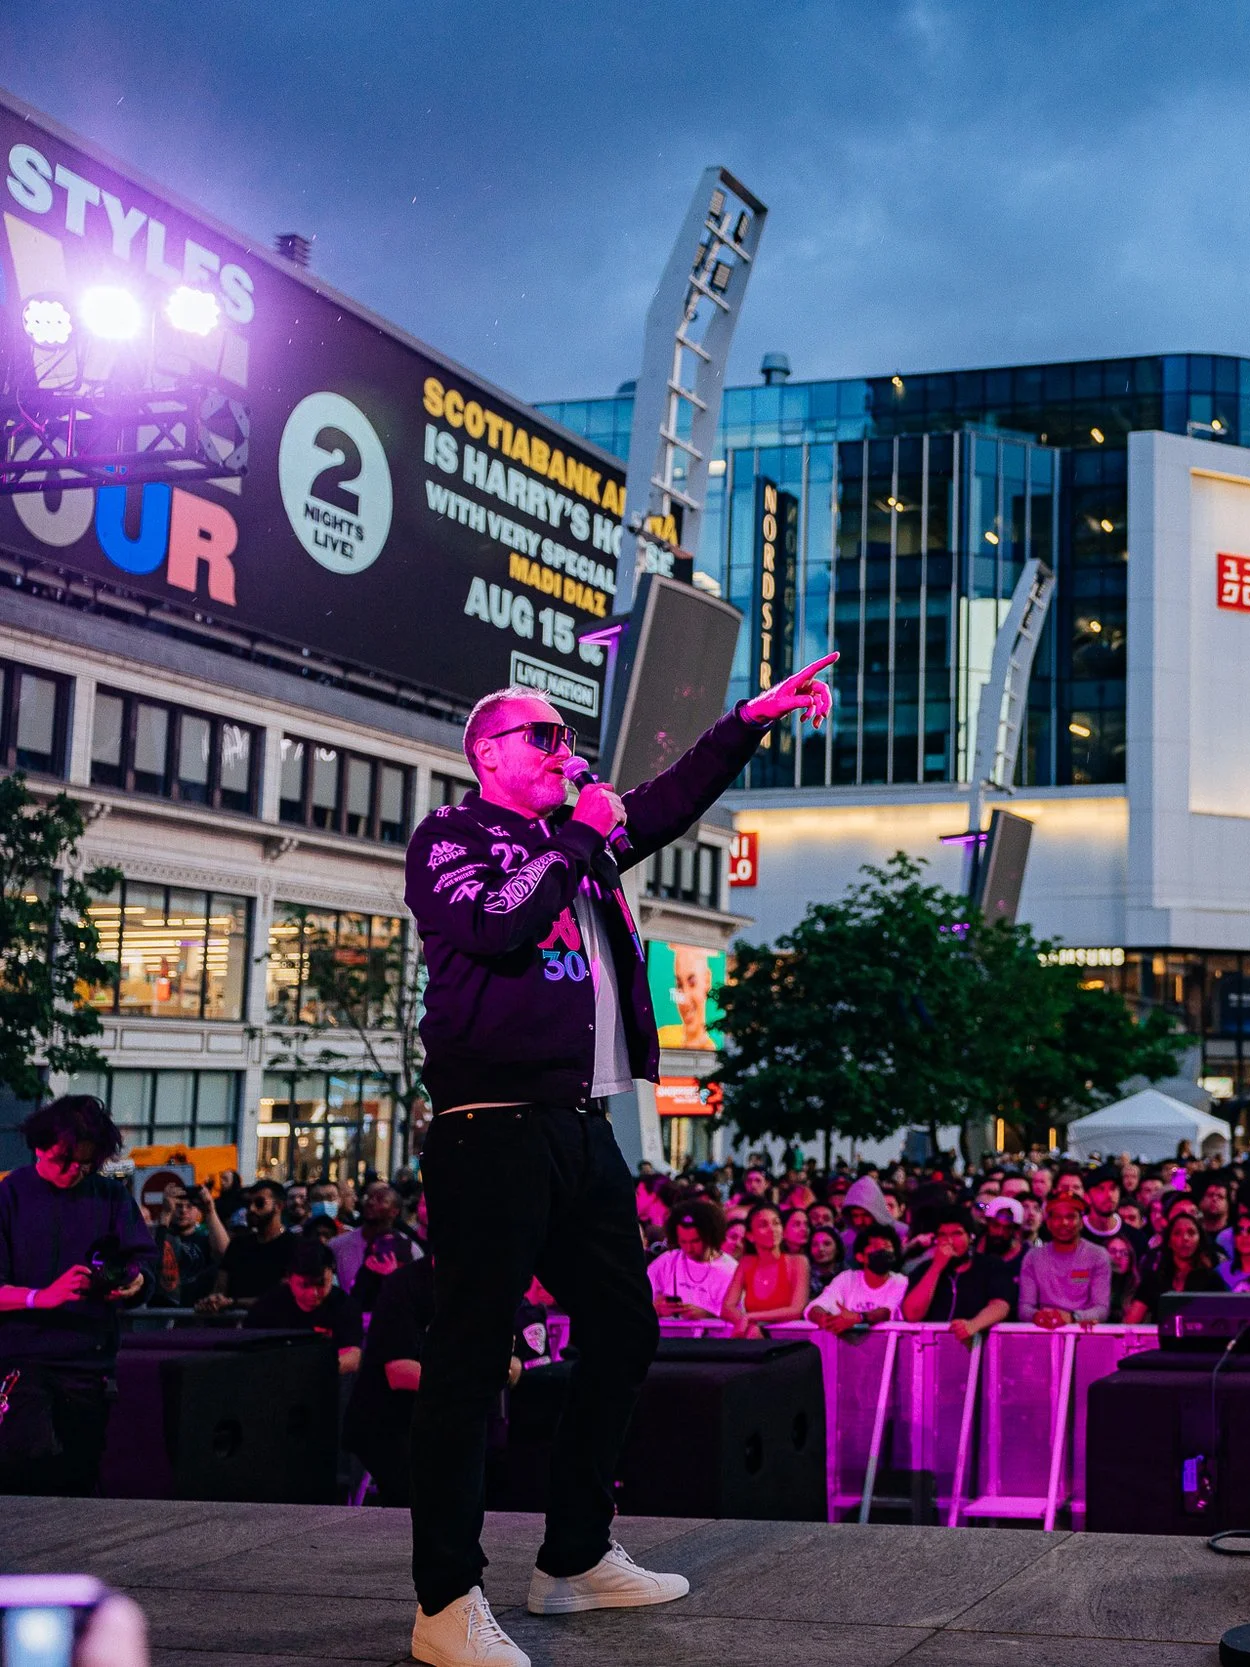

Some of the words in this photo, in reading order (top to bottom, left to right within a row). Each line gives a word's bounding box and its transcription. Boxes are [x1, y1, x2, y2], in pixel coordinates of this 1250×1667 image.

[6, 143, 255, 324] STYLES
[308, 425, 363, 518] 2
[423, 376, 602, 505] SCOTIABANK
[424, 422, 459, 474] IS
[462, 444, 591, 543] HARRY'S
[303, 502, 365, 542] NIGHTS
[425, 480, 487, 535] WITH
[486, 509, 542, 558] VERY
[540, 537, 616, 592] SPECIAL
[463, 575, 535, 640] AUG
[538, 606, 576, 655] 15
[509, 552, 563, 599] MADI
[562, 575, 608, 619] DIAZ
[758, 484, 778, 751] NORDSTRM
[542, 950, 587, 982] 30
